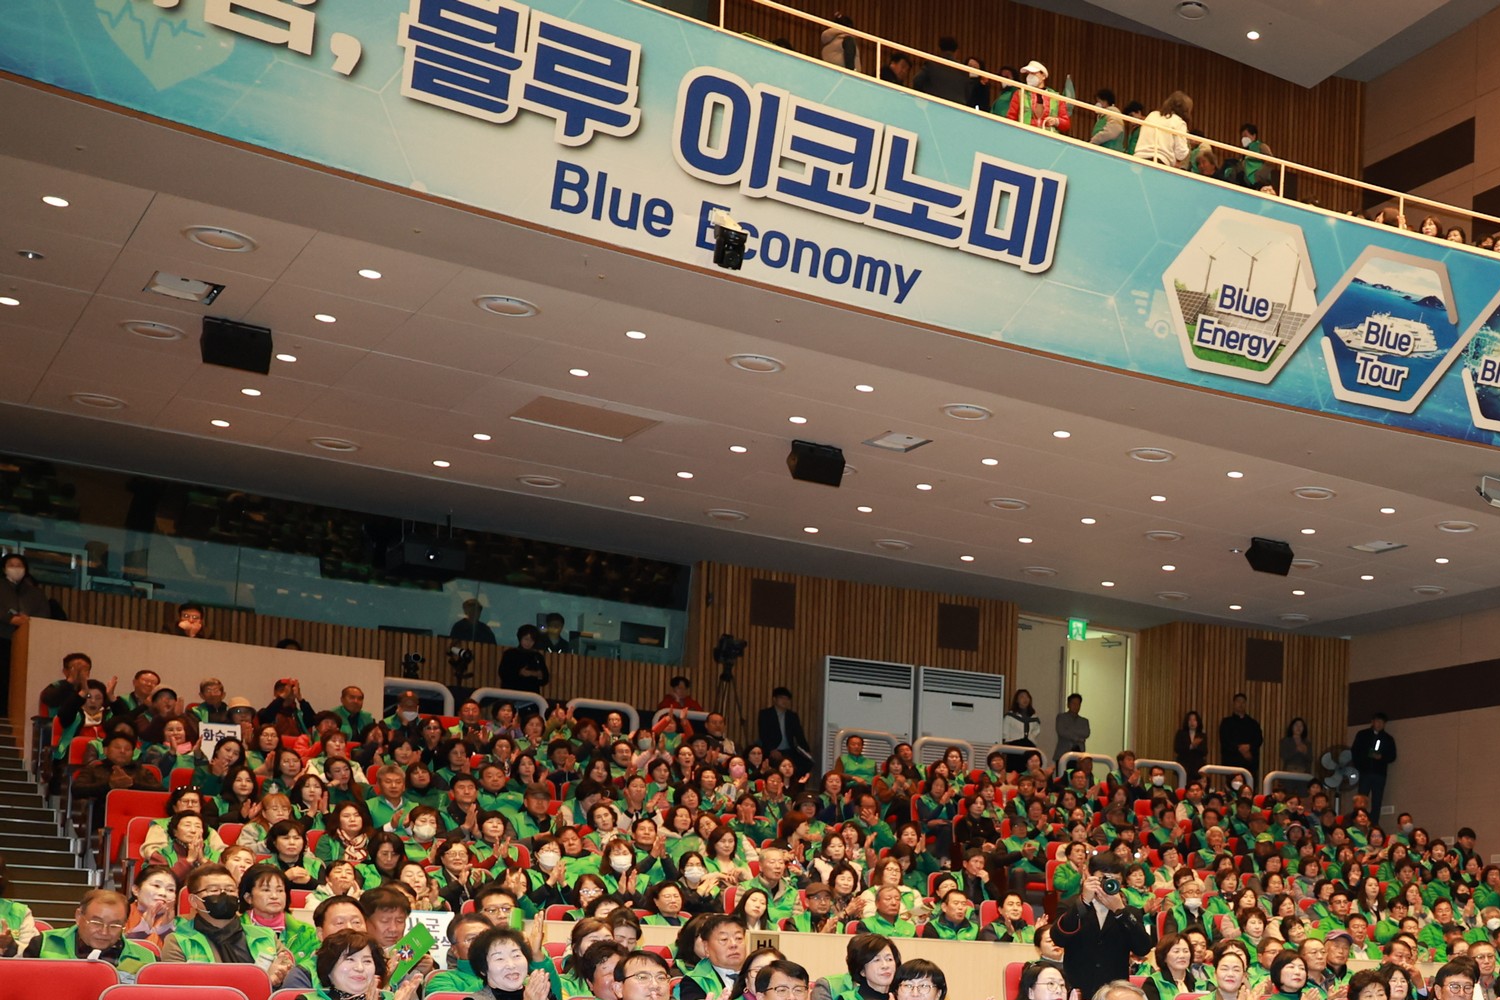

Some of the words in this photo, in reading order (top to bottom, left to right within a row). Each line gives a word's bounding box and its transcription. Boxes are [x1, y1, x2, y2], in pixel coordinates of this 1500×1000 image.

[678, 74, 1062, 268] 이코노미
[549, 160, 675, 238] Blue
[1219, 283, 1270, 318] Blue
[1196, 318, 1277, 360] Energy
[1364, 320, 1412, 354] Blue
[1357, 357, 1405, 389] Tour
